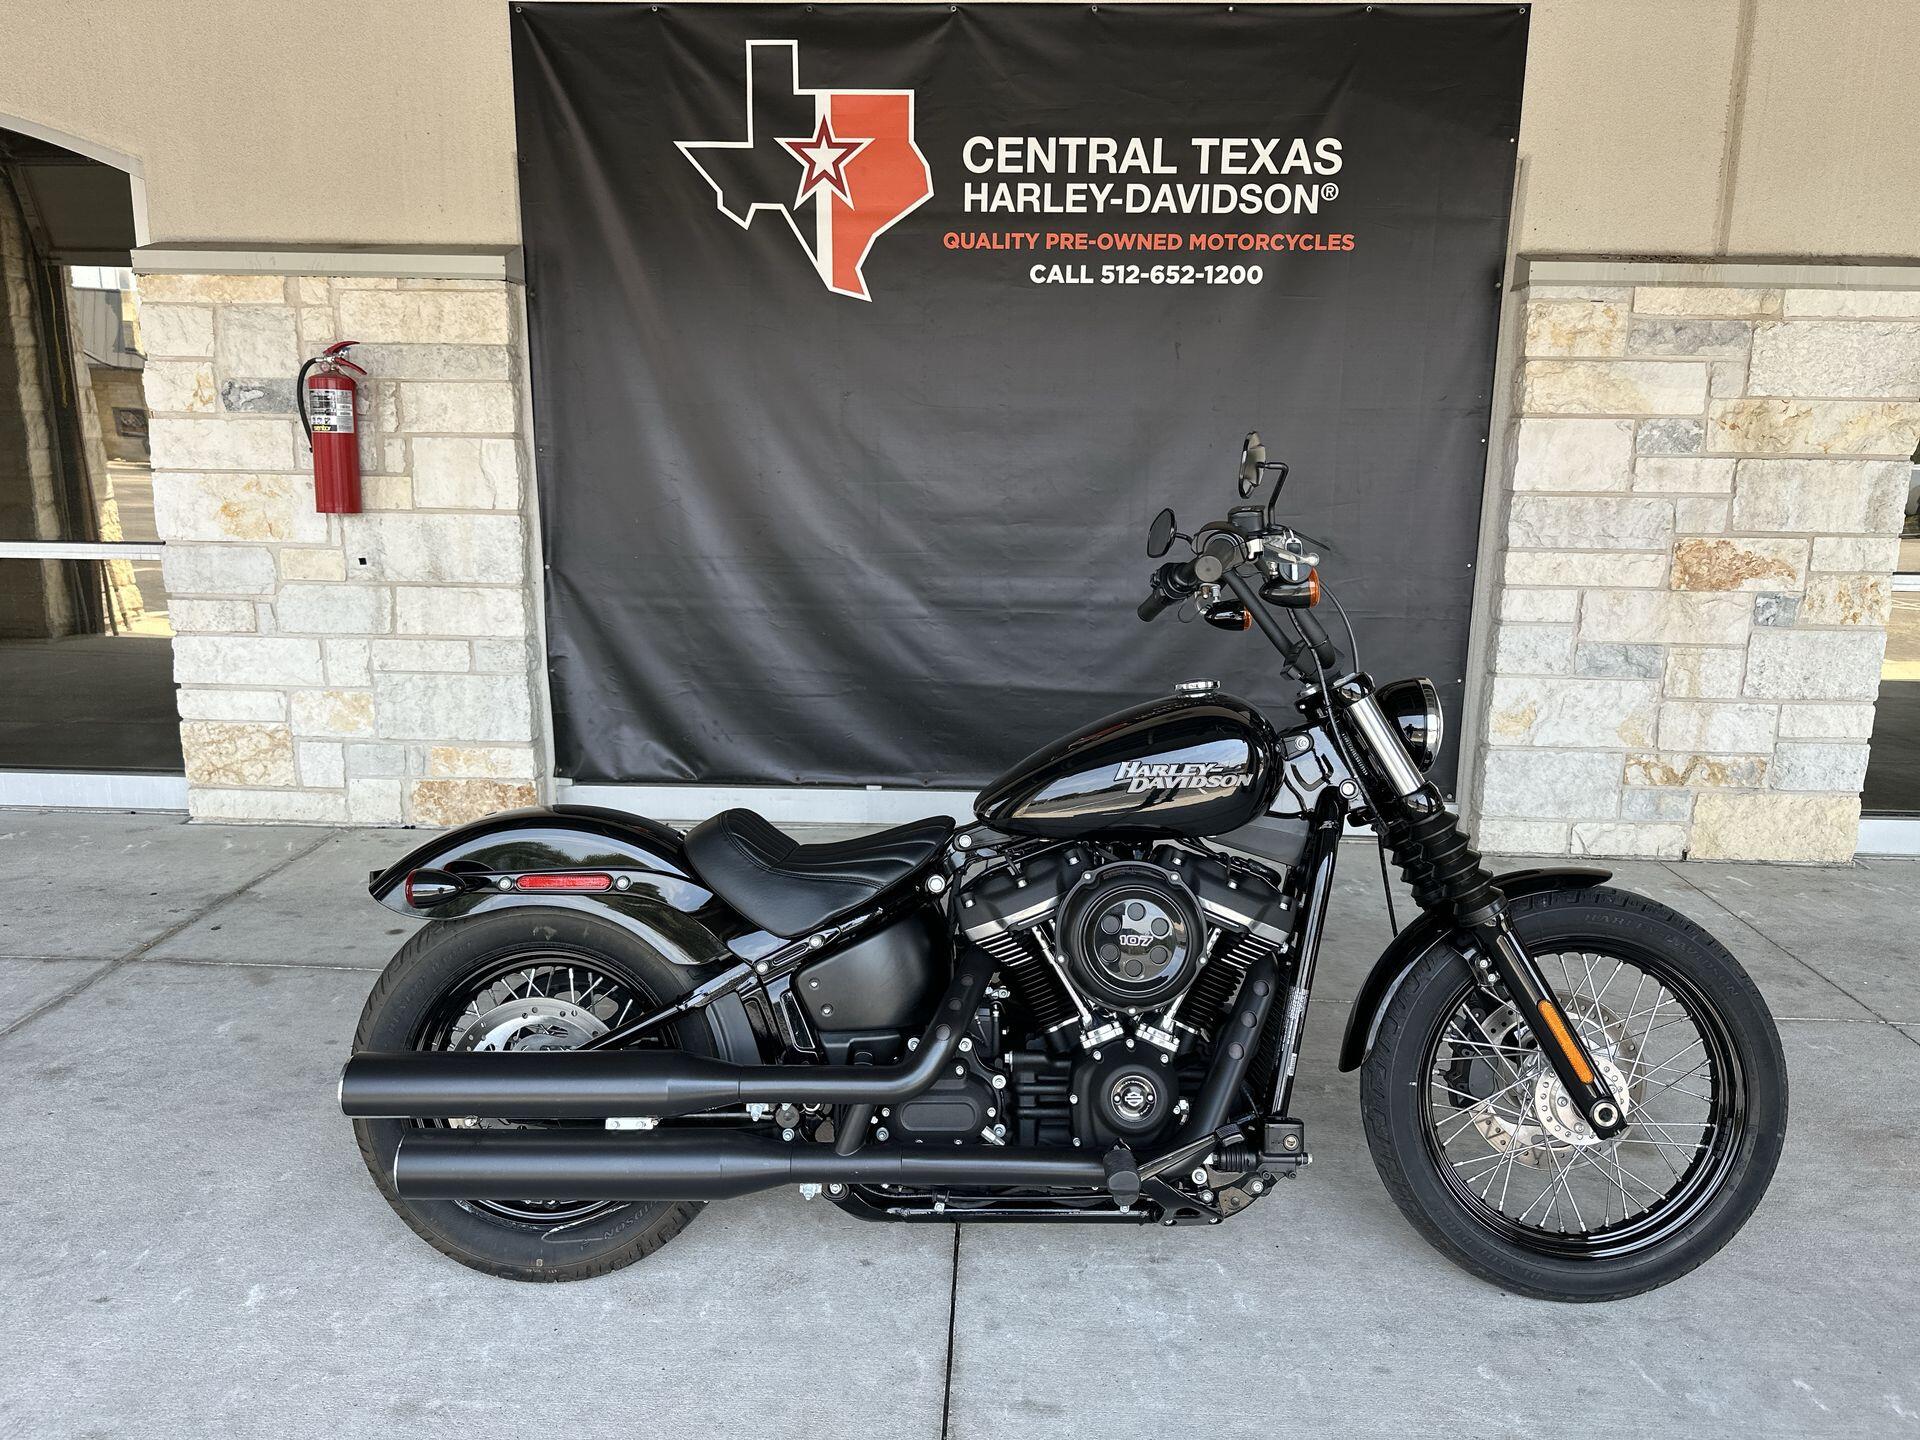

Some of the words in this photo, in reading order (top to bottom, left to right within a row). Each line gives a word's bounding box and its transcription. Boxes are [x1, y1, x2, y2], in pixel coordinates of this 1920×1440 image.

[963, 136, 1178, 174] CENTRAL
[1192, 138, 1343, 176] TEXAS
[942, 231, 1039, 251] QUALITY
[1045, 231, 1183, 251] PRE-OWNED
[1189, 232, 1356, 252] MOTORCYCLES
[1029, 264, 1094, 284] CALL
[1100, 264, 1264, 285] 512-652-1200
[1126, 773, 1253, 794] DAVIDSON
[1118, 934, 1155, 947] 107
